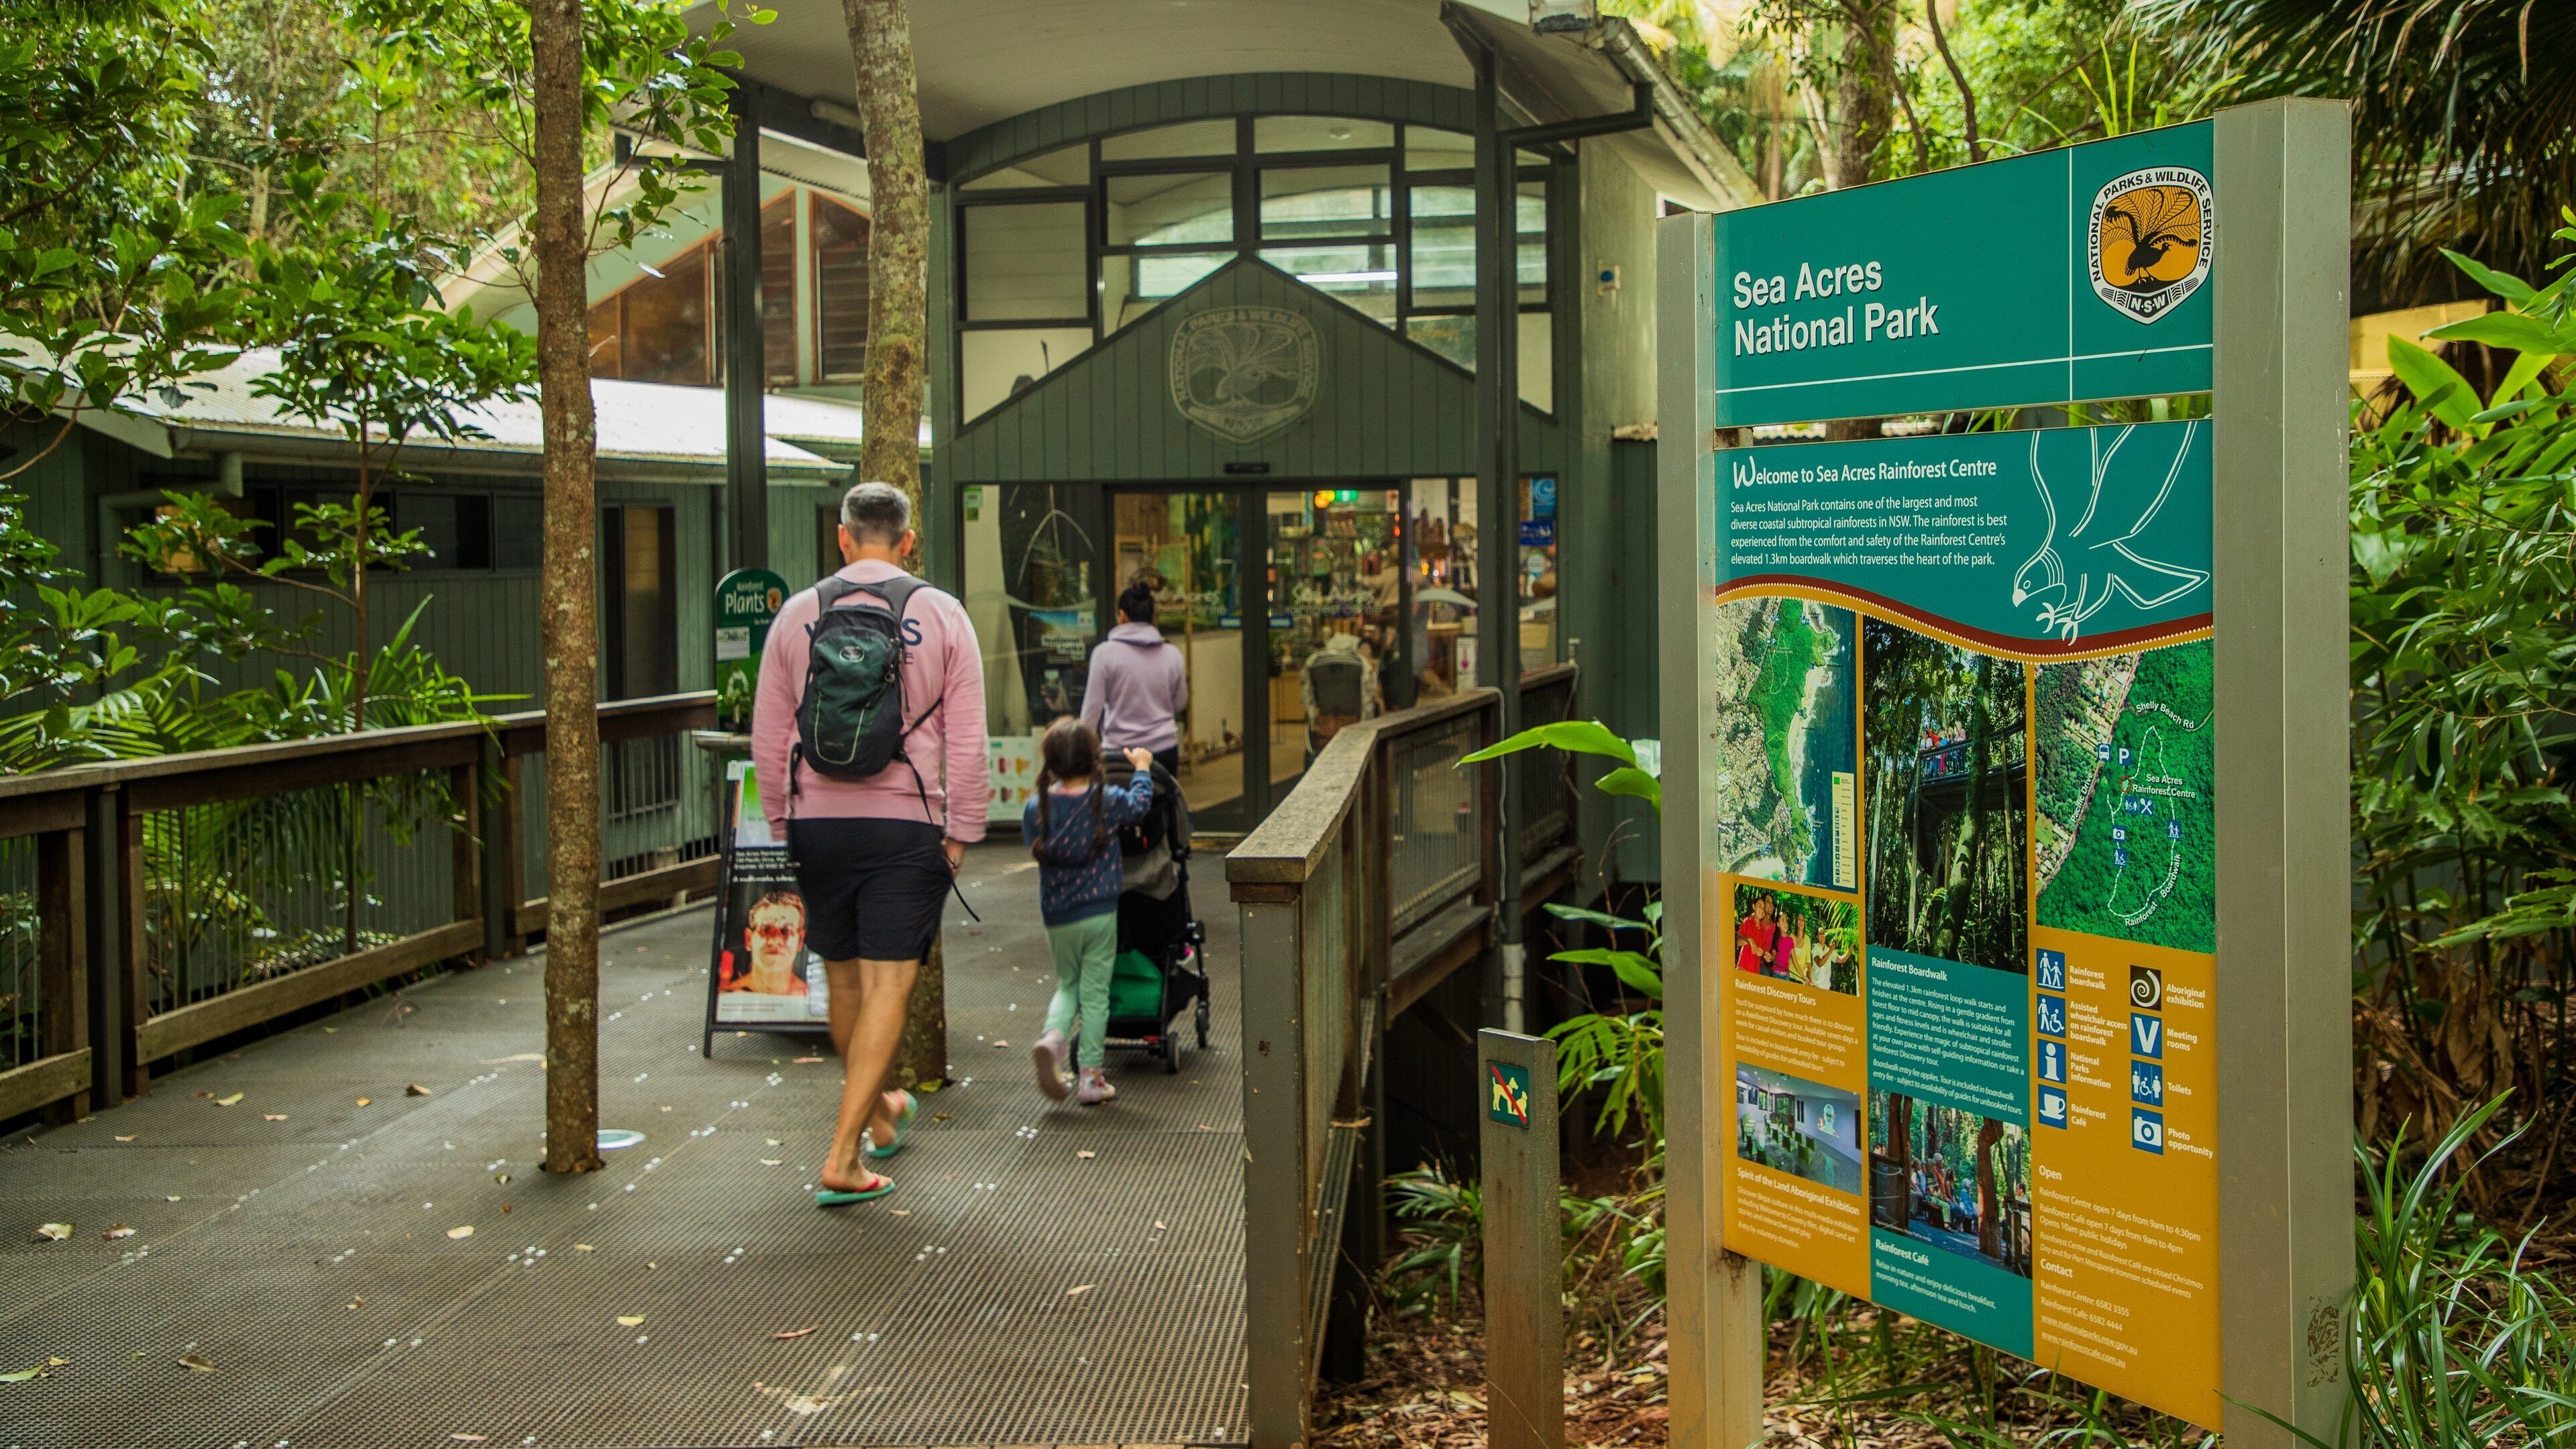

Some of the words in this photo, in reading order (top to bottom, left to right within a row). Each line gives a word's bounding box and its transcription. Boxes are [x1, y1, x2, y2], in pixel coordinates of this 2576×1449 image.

[2090, 202, 2104, 282] NATIONAL
[2103, 175, 2143, 200] PARKS
[2145, 173, 2152, 183] &
[2155, 171, 2207, 197] WILDLIFE
[2198, 198, 2211, 268] SERVICE
[1733, 271, 1785, 308] Sea
[1794, 261, 1882, 300] Acres
[1735, 305, 1853, 356] National
[1865, 296, 1938, 341] Park
[1733, 455, 1798, 489] Welcome
[1800, 468, 1814, 483] to
[1816, 465, 1838, 482] Sea
[1841, 464, 1875, 481] Acres
[1879, 460, 1946, 479] Rainforest
[1949, 459, 1996, 477] Centre
[1731, 501, 1744, 512] Sea
[1745, 501, 1766, 512] Acres
[1767, 499, 1799, 511] National
[1802, 499, 1819, 510] Park
[1820, 498, 1855, 510] contains
[1857, 500, 1873, 509] one
[1875, 496, 1885, 509] of
[1886, 496, 1900, 509] the
[1902, 496, 1932, 511] largest
[1934, 494, 1952, 507] and
[1954, 496, 1977, 507] most
[1731, 518, 1757, 530] diverse
[1759, 517, 1785, 529] coastal
[1787, 516, 1831, 531] subtropical
[1833, 516, 1877, 528] rainforests
[1879, 516, 1887, 527] in
[1889, 515, 1911, 527] NSW.
[1912, 514, 1929, 526] The
[1931, 513, 1975, 526] rainforest
[1977, 514, 1984, 526] is
[1987, 513, 2007, 525] best
[1731, 535, 1777, 549] experienced
[1778, 535, 1797, 546] from
[1798, 535, 1812, 546] the
[1814, 534, 1846, 546] comfort
[1848, 534, 1864, 546] and
[1866, 533, 1891, 549] safety
[1893, 533, 1902, 546] of
[1904, 533, 1919, 546] the
[1921, 533, 1966, 545] Rainforest
[1968, 533, 2005, 545] Centre's
[1731, 552, 1762, 564] elevated
[1765, 552, 1787, 564] 1.3km
[1789, 552, 1831, 564] boardwalk
[1833, 552, 1857, 564] which
[1859, 554, 1897, 564] traverses
[1899, 552, 1914, 564] the
[1916, 552, 1940, 565] heart
[1942, 552, 1952, 564] of
[1953, 552, 1969, 565] the
[1971, 552, 1994, 567] park.
[725, 591, 765, 615] Plants
[2136, 701, 2159, 713] Shelly
[2160, 703, 2181, 724] Beach
[2183, 719, 2194, 729] Rd
[2119, 748, 2130, 764] P
[2146, 774, 2159, 783] Sea
[2161, 775, 2183, 785] Acres
[2071, 795, 2084, 823] Pacific
[2081, 773, 2093, 794] Drive
[2133, 785, 2169, 795] Rainforest
[2171, 789, 2195, 798] Centre
[2125, 901, 2158, 926] Rainforest
[2160, 854, 2181, 898] Boardwalk
[1872, 957, 1907, 973] Rainforest
[1908, 964, 1947, 981] Boardwalk
[2069, 965, 2104, 980] Rainforest
[2070, 976, 2105, 990] boardwalk
[2166, 984, 2205, 998] Aboriginal
[1735, 979, 1766, 994] Rainforest
[1766, 986, 1797, 1002] Discovery
[1798, 993, 1816, 1005] Tours
[1872, 977, 1882, 986] The
[1882, 980, 1905, 991] elevated
[1906, 985, 1922, 994] 1.3km
[1923, 989, 1949, 1000] rainforest
[1950, 993, 1963, 1004] loop
[1963, 998, 1977, 1006] walk
[1977, 1001, 1994, 1010] starts
[2070, 1001, 2098, 1013] Assisted
[2166, 996, 2204, 1008] exhibition
[2070, 1012, 2105, 1025] wheelchair
[2106, 1020, 2127, 1029] access
[2070, 1031, 2106, 1045] boardwalk
[2080, 1025, 2113, 1037] rainforest
[2134, 1017, 2159, 1054] V
[2167, 1028, 2197, 1044] Meeting
[2167, 1041, 2190, 1051] rooms
[2070, 1052, 2099, 1065] National
[2071, 1062, 2089, 1074] Parks
[2071, 1072, 2111, 1088] information
[2167, 1082, 2191, 1095] Toilets
[2071, 1104, 2106, 1119] Rainforest
[2071, 1116, 2086, 1126] Café
[2168, 1128, 2190, 1140] Photo
[2168, 1140, 2213, 1159] opportunity
[2039, 1165, 2061, 1180] Open
[1738, 1167, 1754, 1180] Spirit
[1754, 1174, 1762, 1182] of
[1762, 1176, 1773, 1186] the
[1773, 1179, 1790, 1192] Land
[1790, 1185, 1824, 1203] Aboriginal
[1825, 1196, 1859, 1215] Exhibition
[2039, 1186, 2070, 1203] Rainforest
[2070, 1196, 2092, 1209] Centre
[2092, 1204, 2110, 1214] open
[2116, 1210, 2132, 1221] days
[2132, 1214, 2149, 1225] from
[2149, 1219, 2165, 1231] 9am
[2165, 1225, 2174, 1233] to
[2174, 1227, 2200, 1241] 4:30pm
[2039, 1204, 2070, 1219] Rainforest
[2070, 1213, 2085, 1224] Café
[2086, 1219, 2103, 1229] open
[2109, 1225, 2125, 1236] days
[2125, 1229, 2142, 1241] from
[2142, 1235, 2158, 1246] 9am
[2158, 1240, 2166, 1248] to
[2167, 1242, 2183, 1254] 4pm
[1875, 1239, 1912, 1260] Rainforest
[1912, 1252, 1929, 1265] Café
[2040, 1258, 2072, 1278] Contact
[2040, 1280, 2071, 1297] Rainforest
[2095, 1299, 2112, 1311] 6582
[2113, 1304, 2129, 1317] 3355
[2041, 1296, 2072, 1314] Rainforest
[2089, 1314, 2105, 1325] 6582
[2106, 1320, 2122, 1331] 4444
